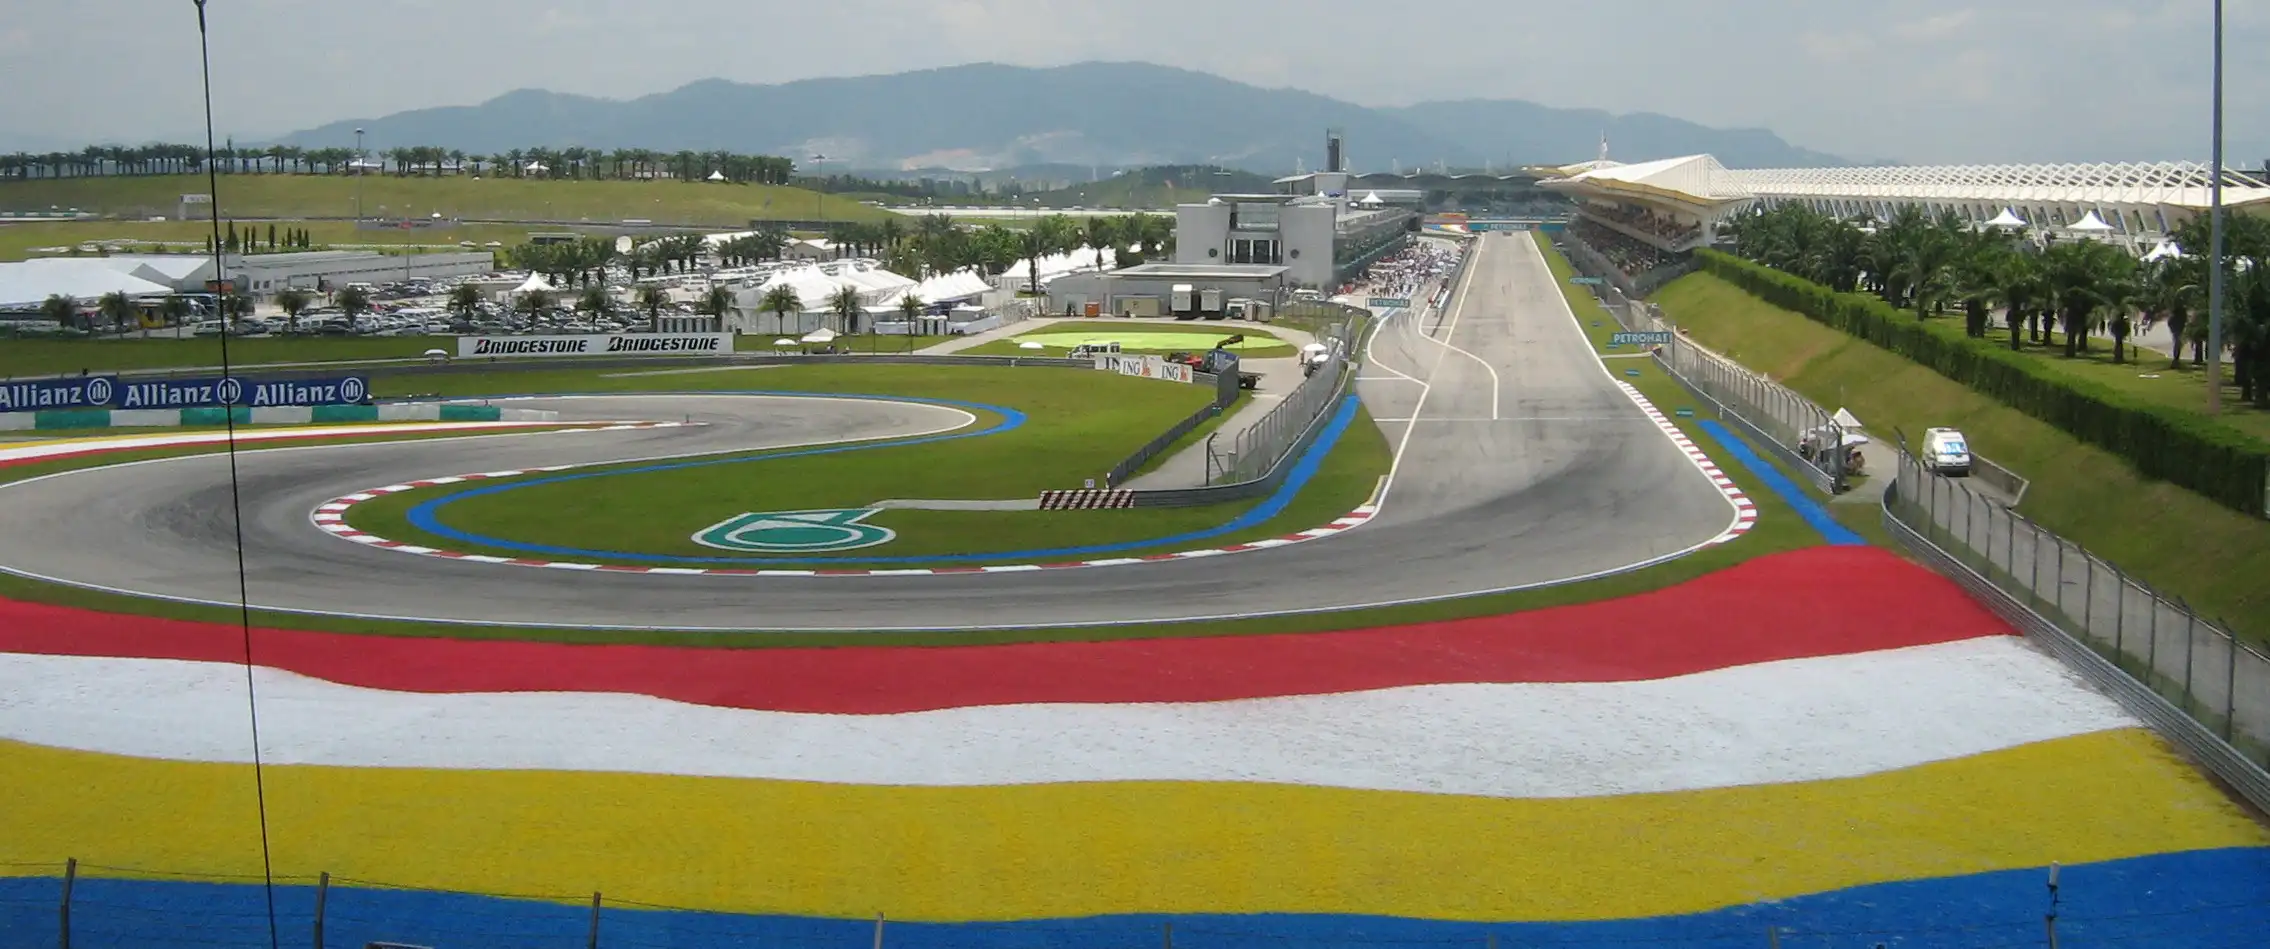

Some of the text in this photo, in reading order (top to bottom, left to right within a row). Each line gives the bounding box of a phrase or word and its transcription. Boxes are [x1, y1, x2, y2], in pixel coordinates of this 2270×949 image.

[474, 336, 720, 354] BRIDGESTONE BRIDGESTONE
[1104, 357, 1120, 370] IN
[1122, 360, 1140, 375] ING
[1162, 365, 1179, 380] ING
[0, 384, 82, 408] Allianz
[125, 383, 212, 407] Allianz
[254, 382, 336, 405] Allianz
